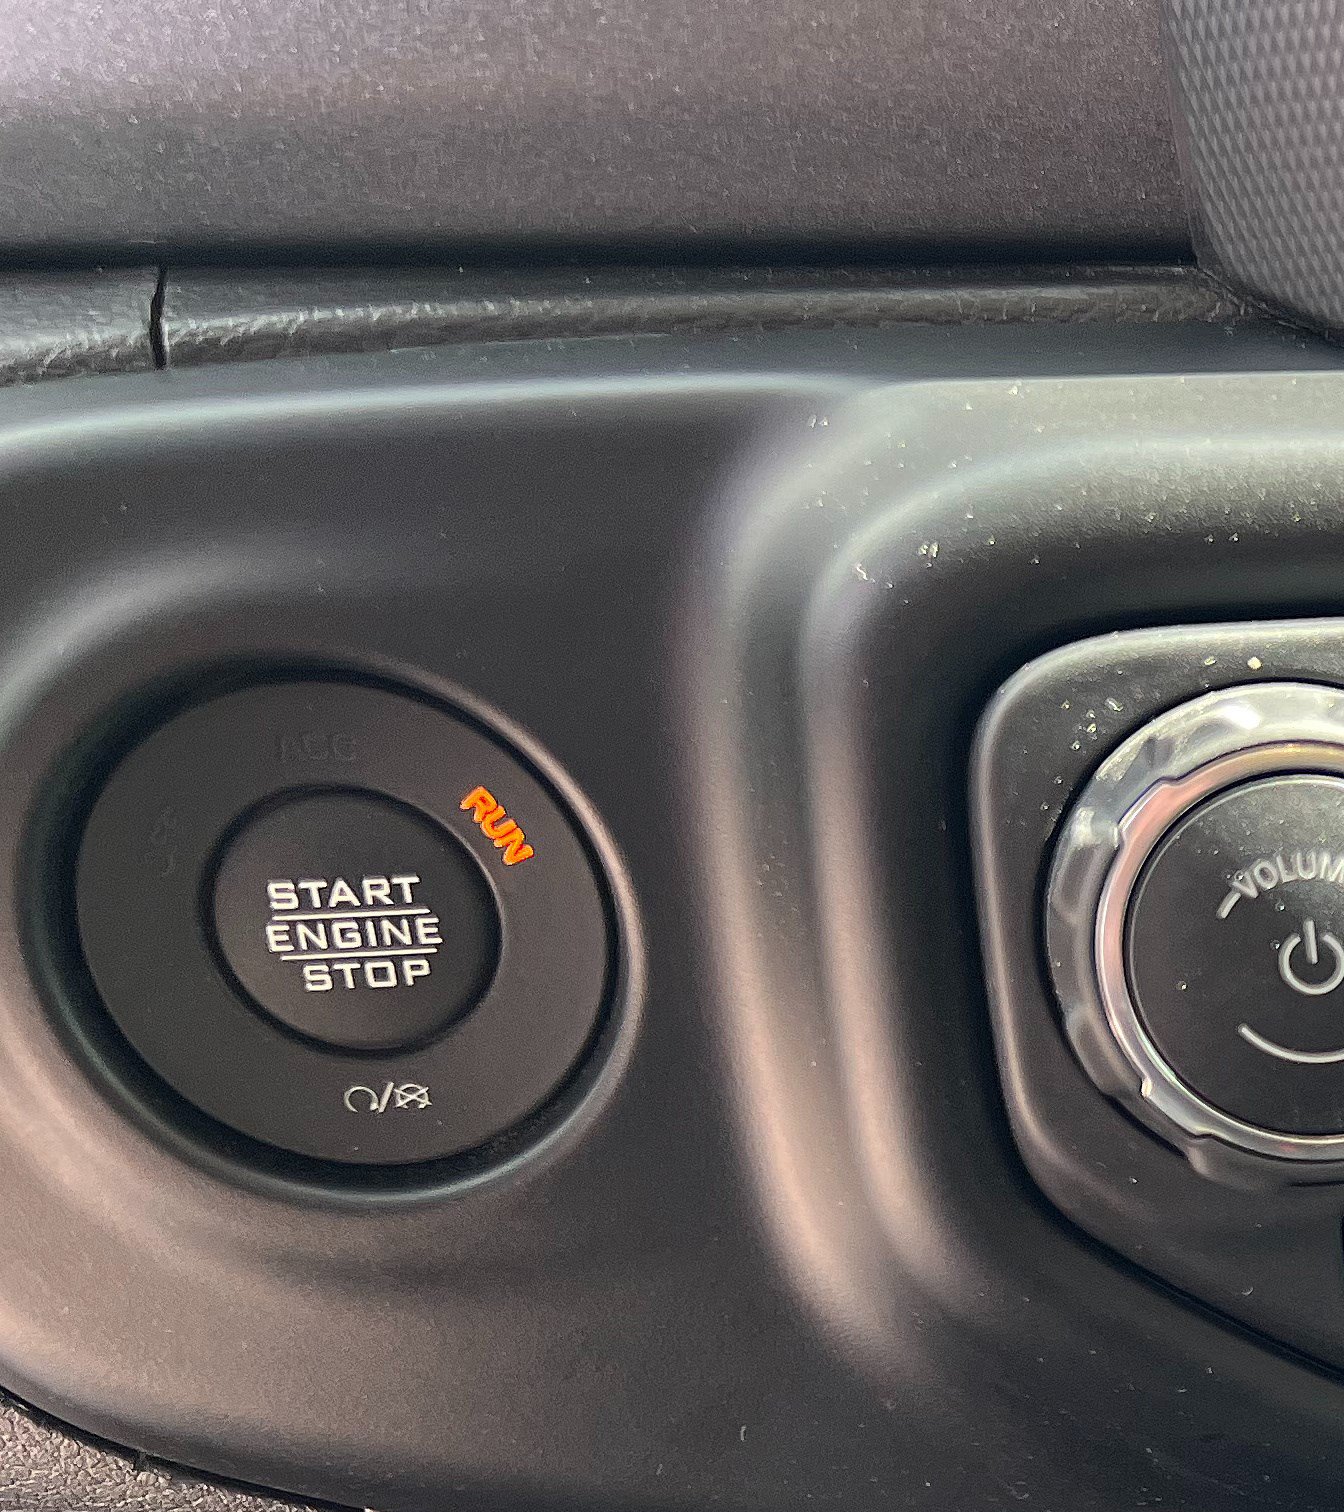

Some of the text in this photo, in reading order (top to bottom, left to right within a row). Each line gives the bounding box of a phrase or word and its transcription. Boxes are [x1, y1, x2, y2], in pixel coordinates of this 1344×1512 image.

[459, 785, 535, 867] RUN
[266, 873, 421, 910] START
[265, 916, 444, 954] ENGINE
[302, 959, 432, 993] STOP
